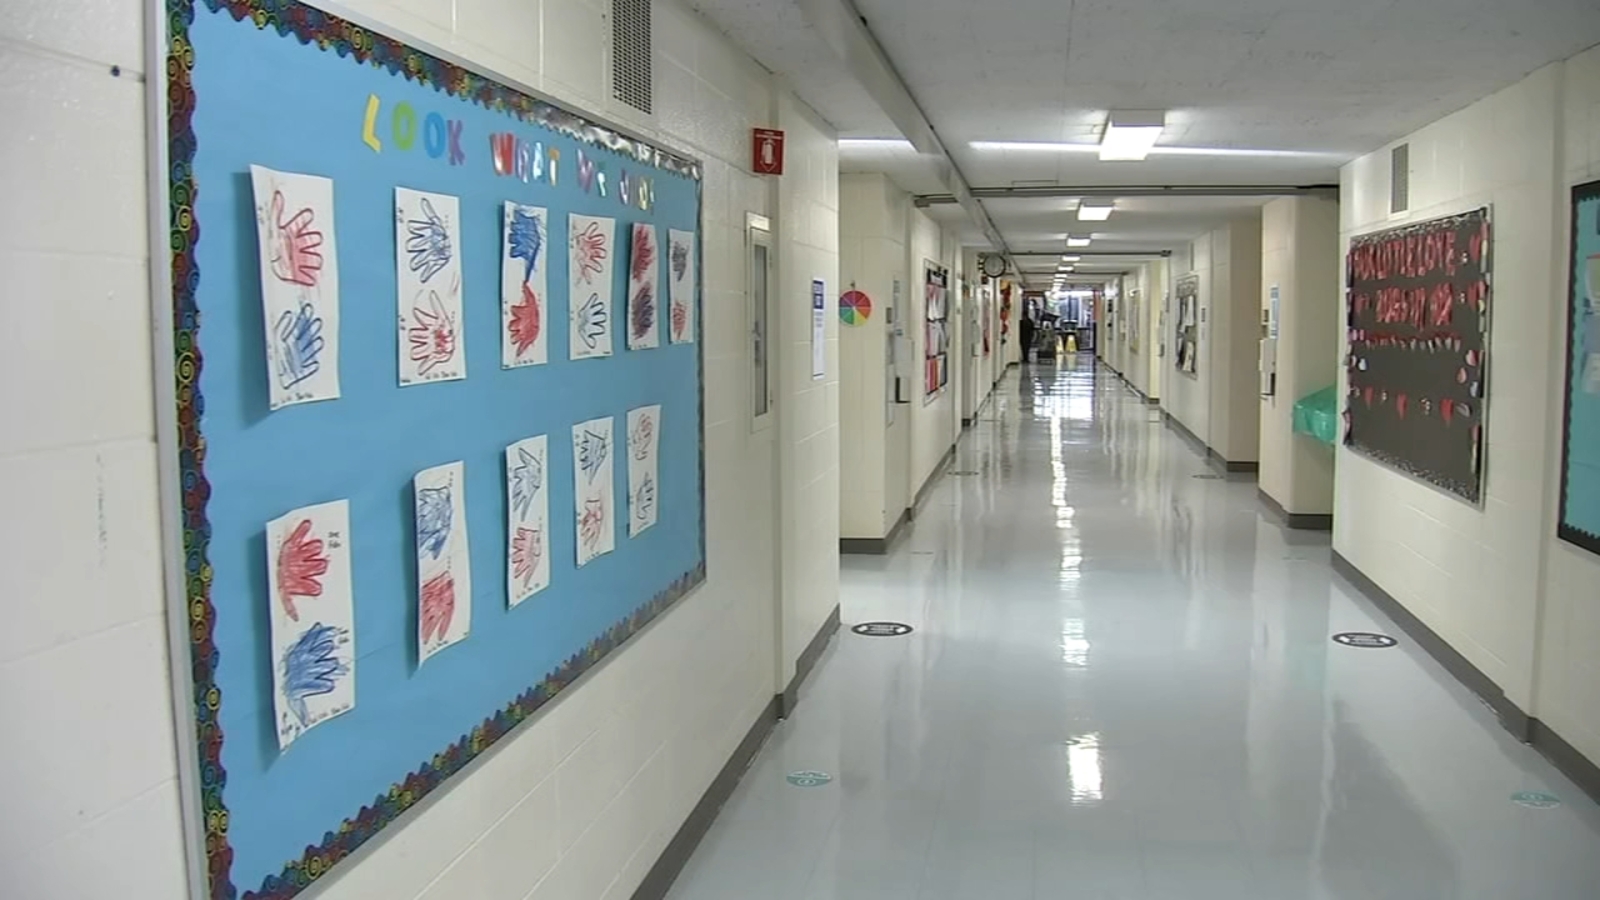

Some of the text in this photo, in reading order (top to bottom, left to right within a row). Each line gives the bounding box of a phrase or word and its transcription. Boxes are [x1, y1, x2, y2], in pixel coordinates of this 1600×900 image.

[362, 93, 465, 165] LOOK
[489, 132, 560, 186] WHAT
[1417, 231, 1457, 276] LOVE
